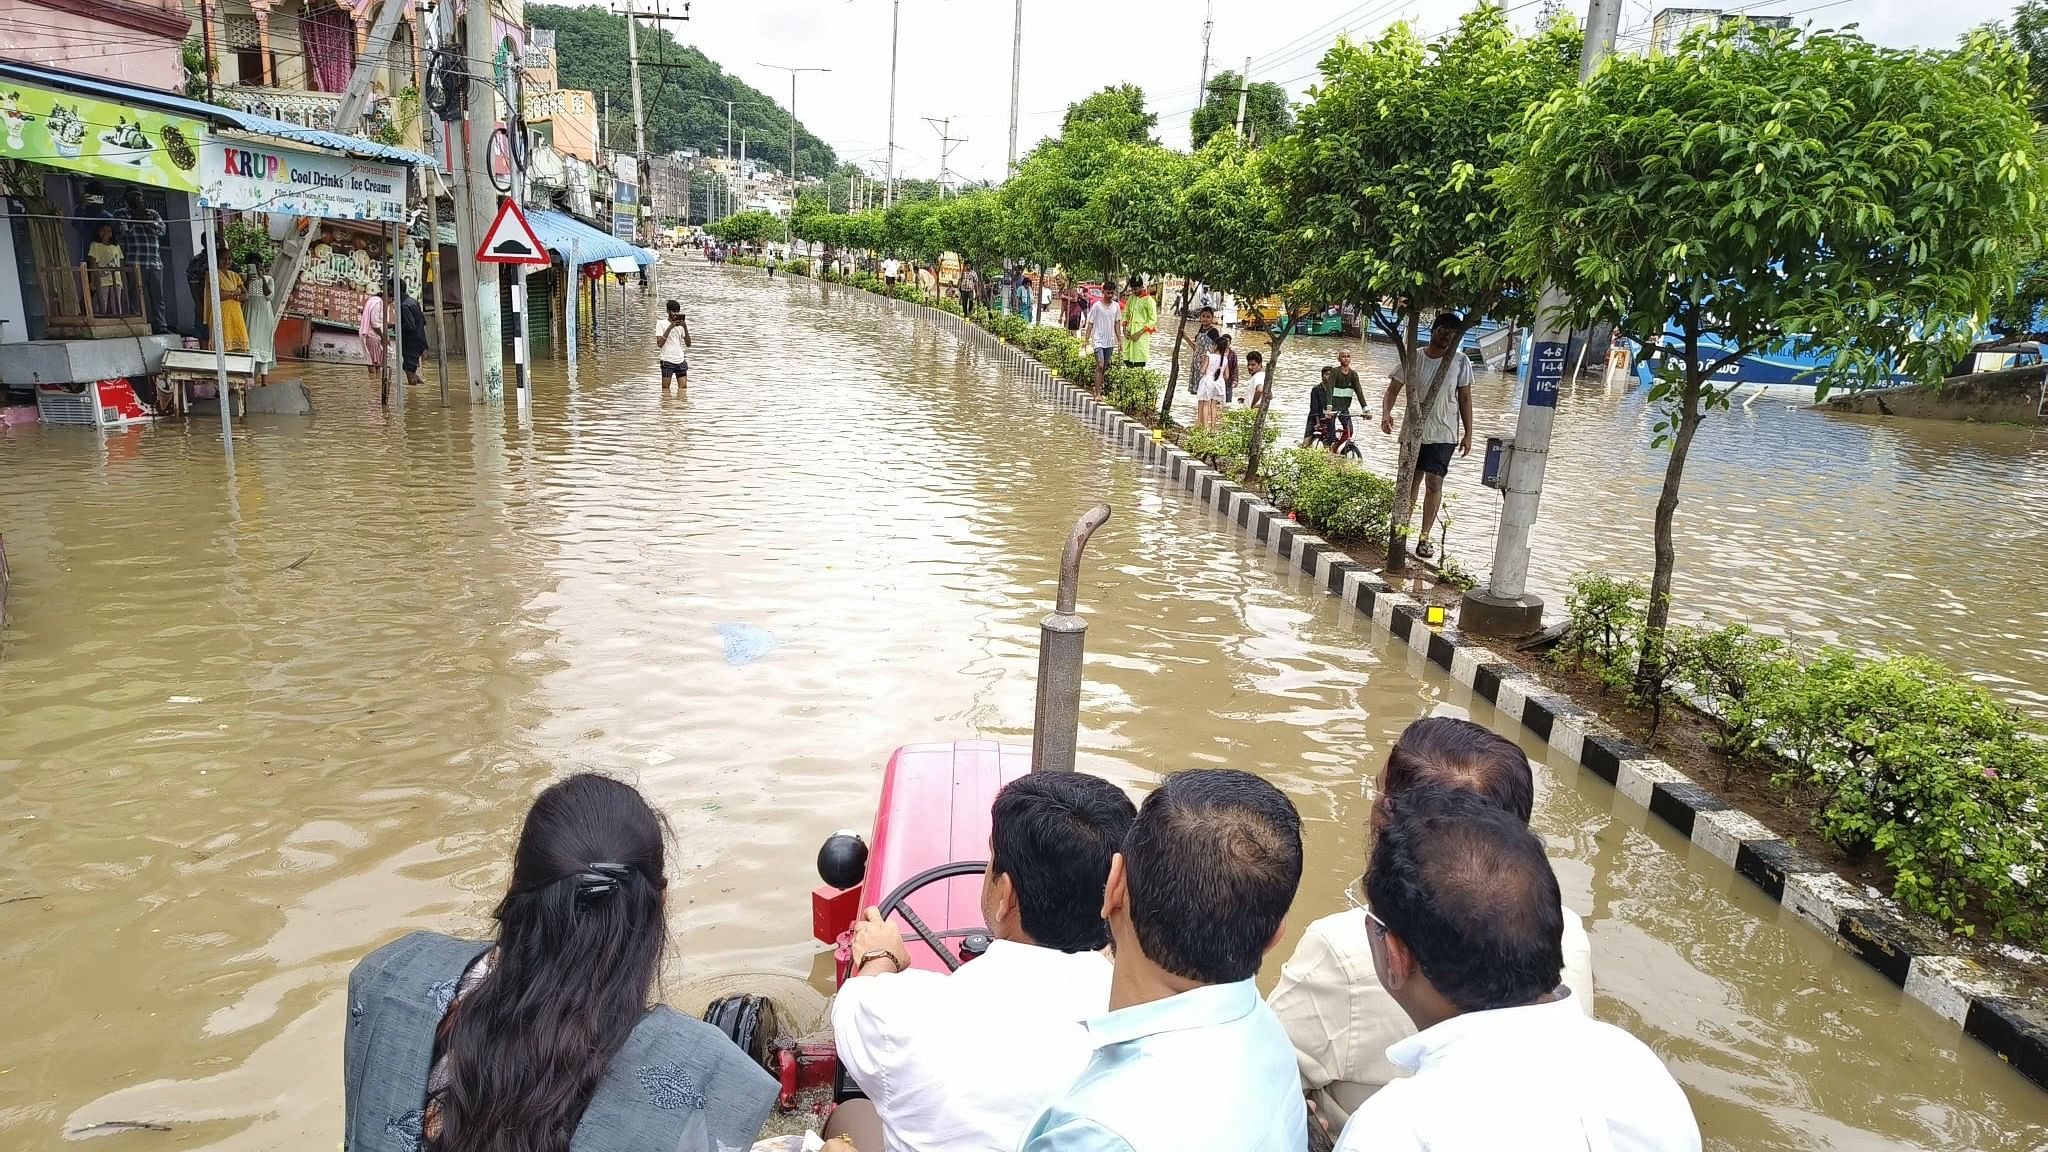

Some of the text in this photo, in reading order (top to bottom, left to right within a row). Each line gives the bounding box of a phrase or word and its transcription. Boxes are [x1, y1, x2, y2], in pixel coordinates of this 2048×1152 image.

[224, 147, 290, 184] KRUPA
[290, 168, 311, 184] Cool
[313, 171, 344, 189] Drinks
[351, 176, 363, 190] Ice
[364, 178, 391, 193] Creams
